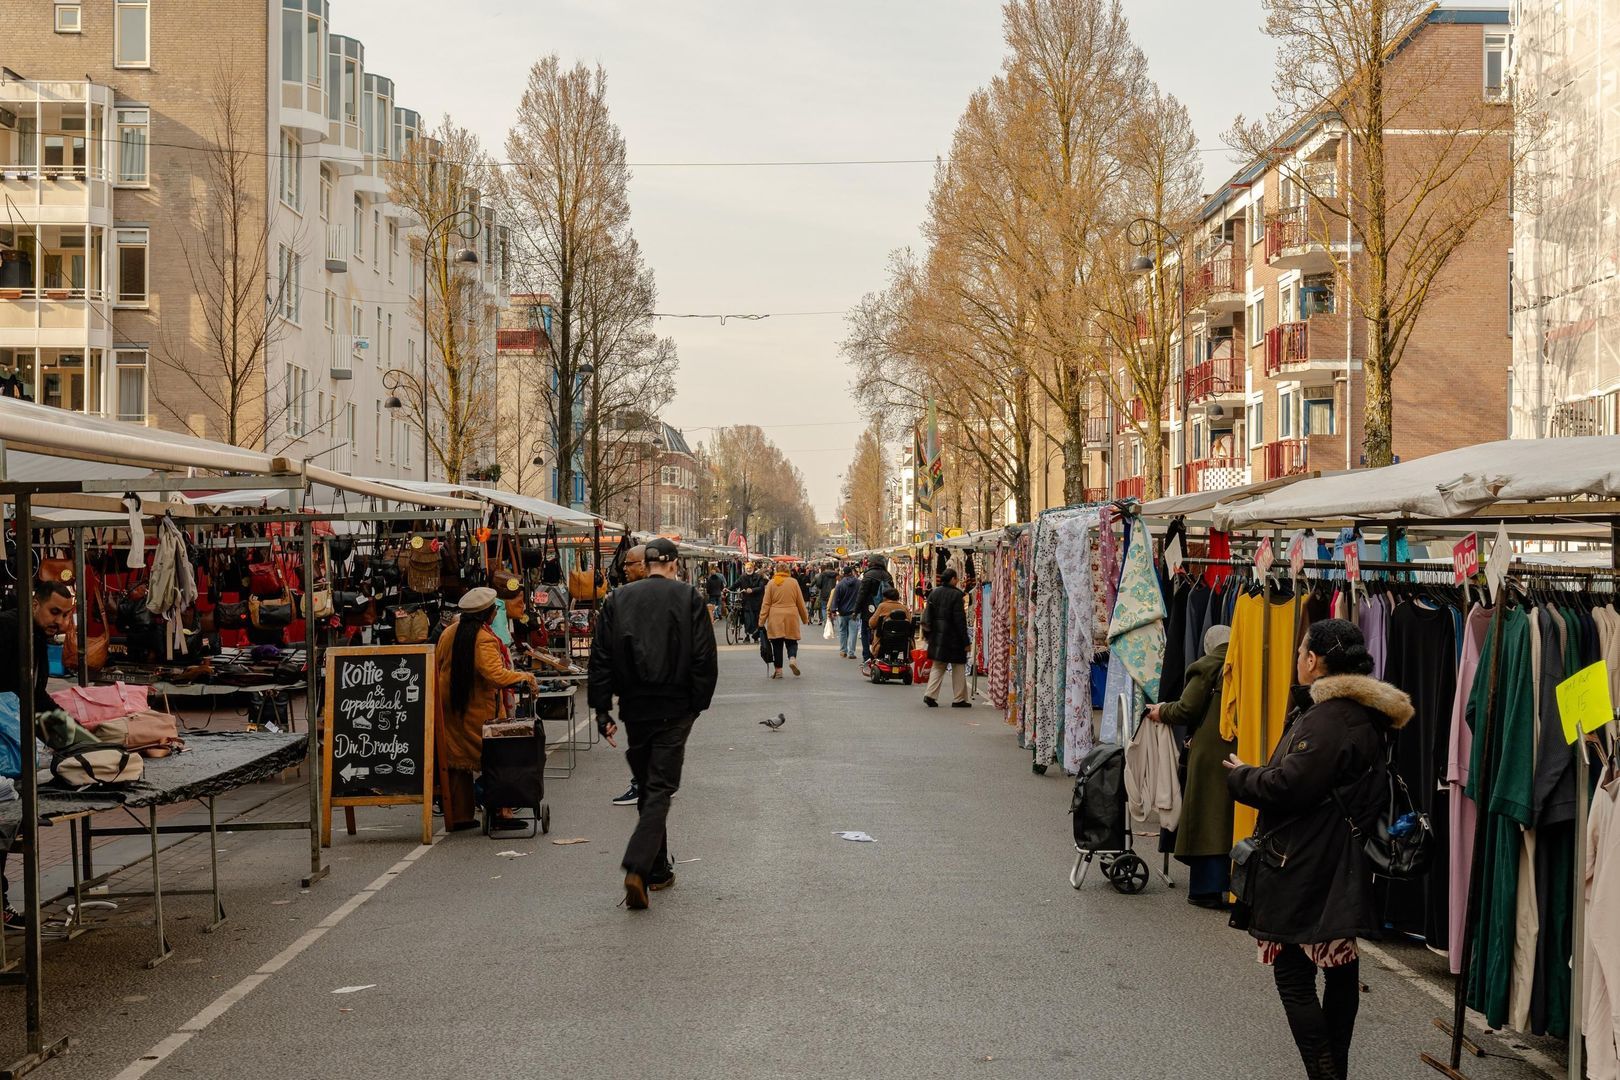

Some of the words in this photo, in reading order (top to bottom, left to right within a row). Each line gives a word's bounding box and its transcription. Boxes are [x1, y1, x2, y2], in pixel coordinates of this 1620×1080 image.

[1455, 549, 1476, 575] 1000
[341, 660, 384, 689] Koffie
[374, 684, 385, 697] &
[340, 690, 403, 720] appelgebak
[358, 733, 409, 760] Broodjes
